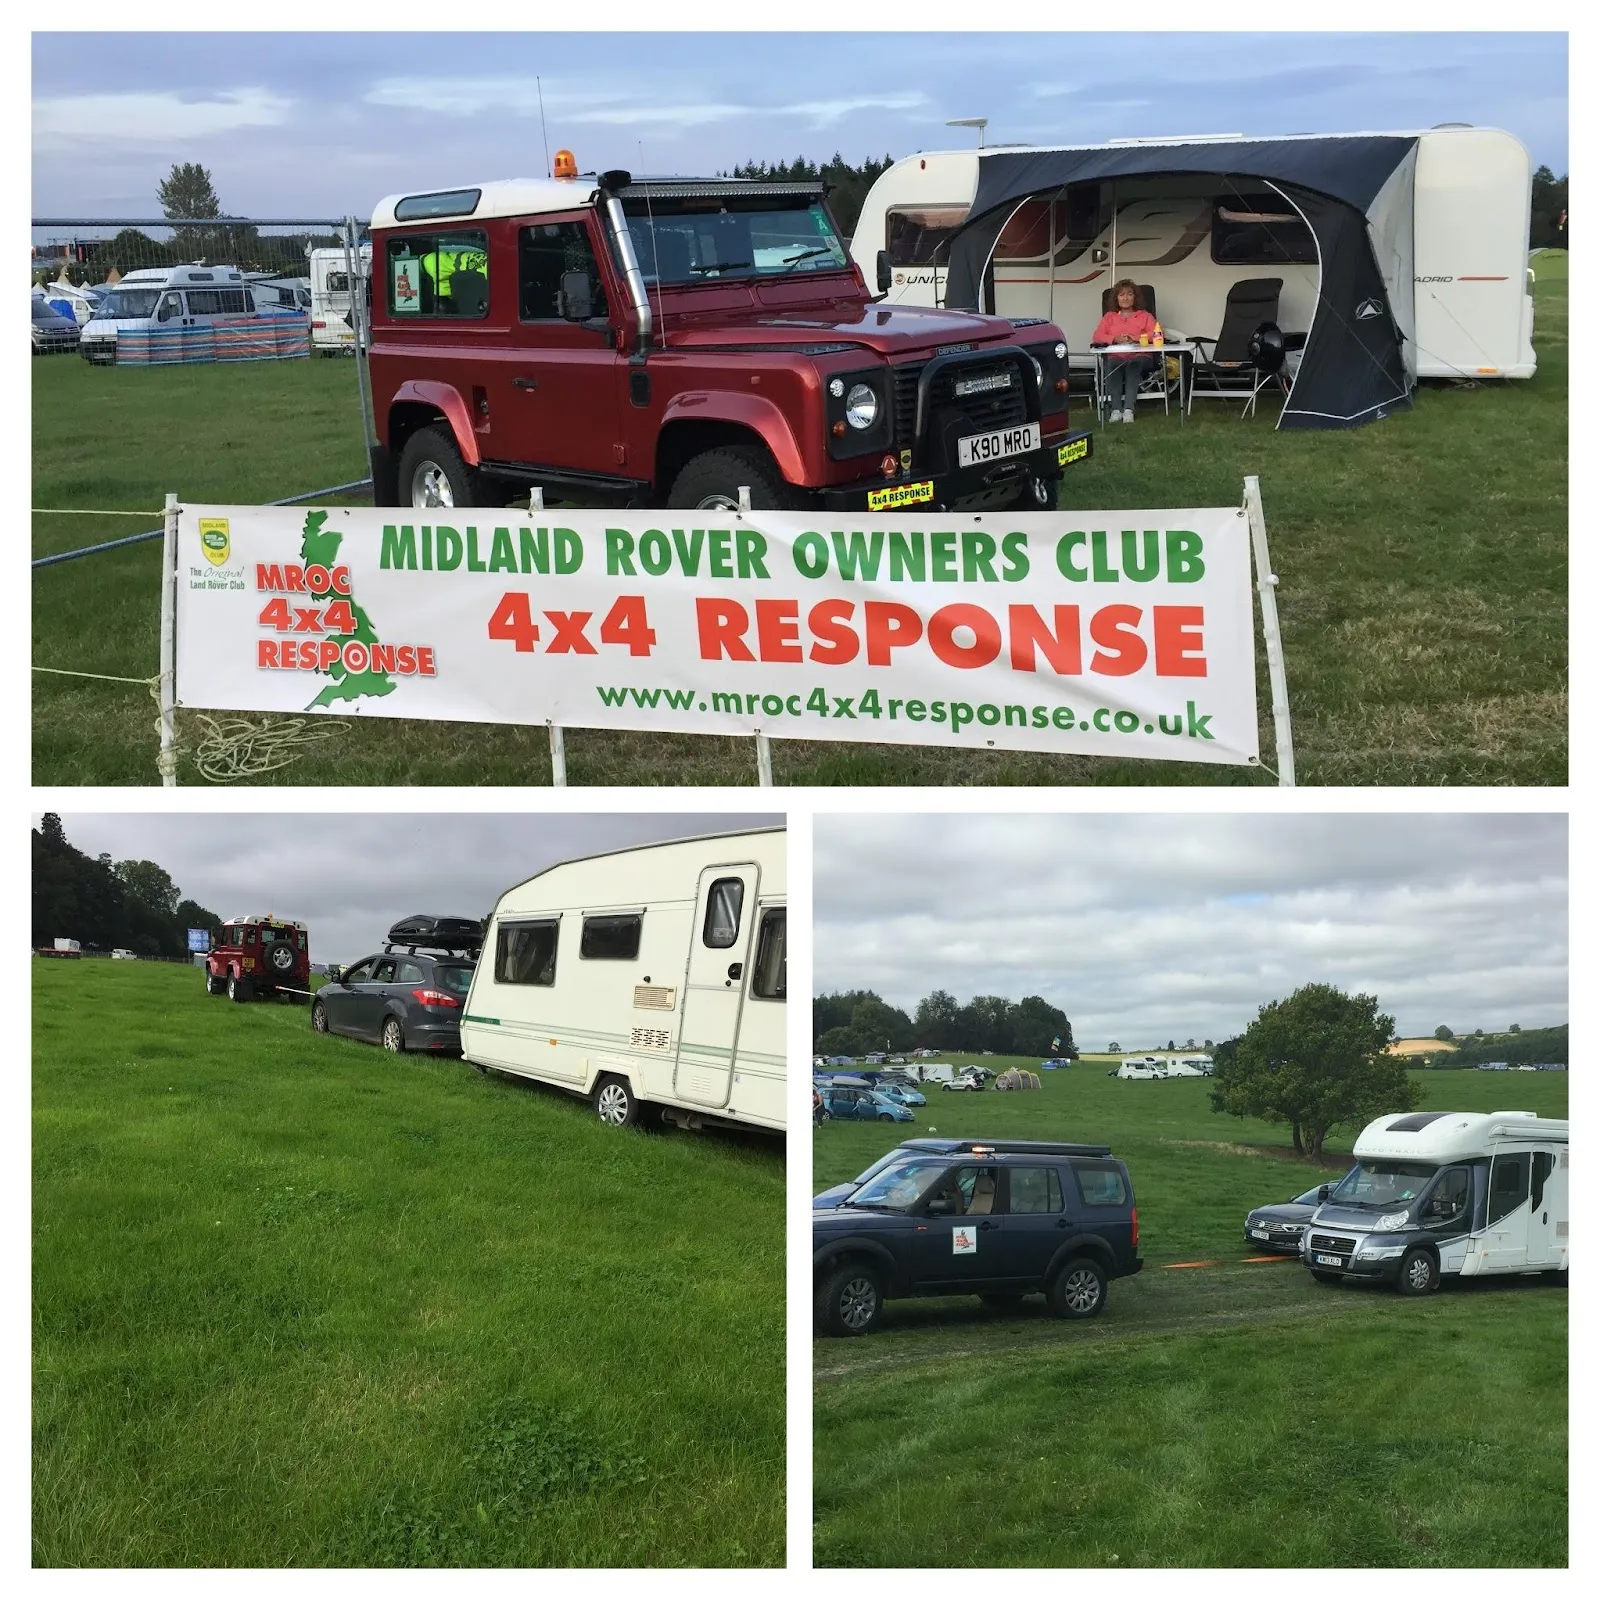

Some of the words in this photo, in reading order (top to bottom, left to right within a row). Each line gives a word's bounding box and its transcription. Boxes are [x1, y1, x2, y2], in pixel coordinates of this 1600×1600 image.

[907, 276, 947, 284] UNIC
[938, 344, 971, 356] DEFENDER
[970, 435, 1000, 462] K90
[1003, 428, 1031, 454] MRO
[872, 494, 887, 505] 4x4
[889, 486, 930, 503] RESPONSE
[379, 525, 584, 575] MIDLAND
[605, 528, 771, 579] ROVER
[792, 531, 1030, 583] OWNERS
[1055, 530, 1206, 584] CLUB
[190, 567, 202, 576] The
[203, 566, 244, 581] Original
[190, 580, 206, 589] Land
[208, 581, 228, 590] Rover
[229, 581, 245, 590] Club
[256, 563, 352, 595] MROC
[258, 597, 357, 635] 4x4
[487, 592, 657, 657] 4x4
[695, 597, 1208, 678] RESPONSE
[257, 638, 437, 676] RESPONSE
[596, 686, 1217, 741] www.mroc4x4response.co.uk
